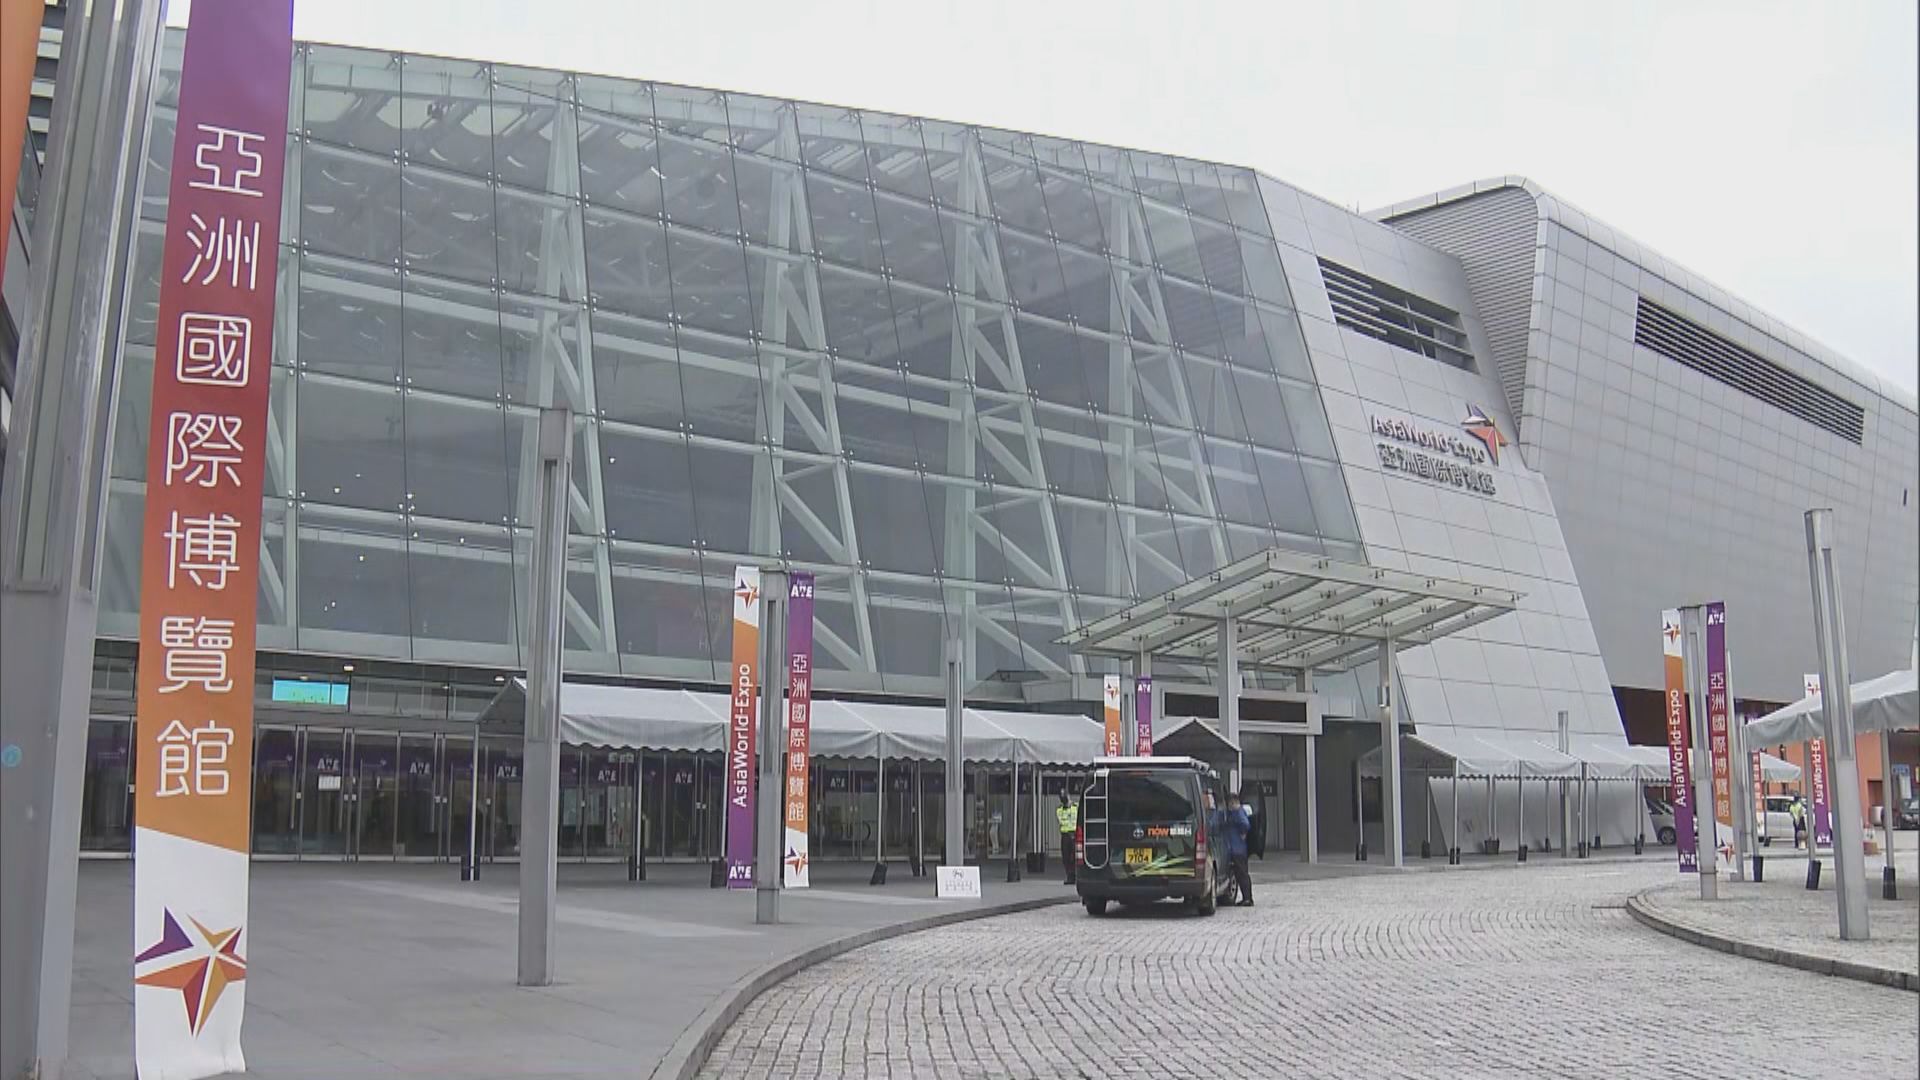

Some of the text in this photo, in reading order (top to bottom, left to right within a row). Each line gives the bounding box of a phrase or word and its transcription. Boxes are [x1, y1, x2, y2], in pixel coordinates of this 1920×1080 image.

[155, 124, 266, 799] 亞洲國際博覽館
[732, 663, 752, 808] AsiaWorld-Expo
[788, 653, 808, 822] 亞洲國際博覽館
[1669, 688, 1687, 807] AsiaWorld-Expo
[1710, 672, 1729, 818] 亞洲國際博覽館
